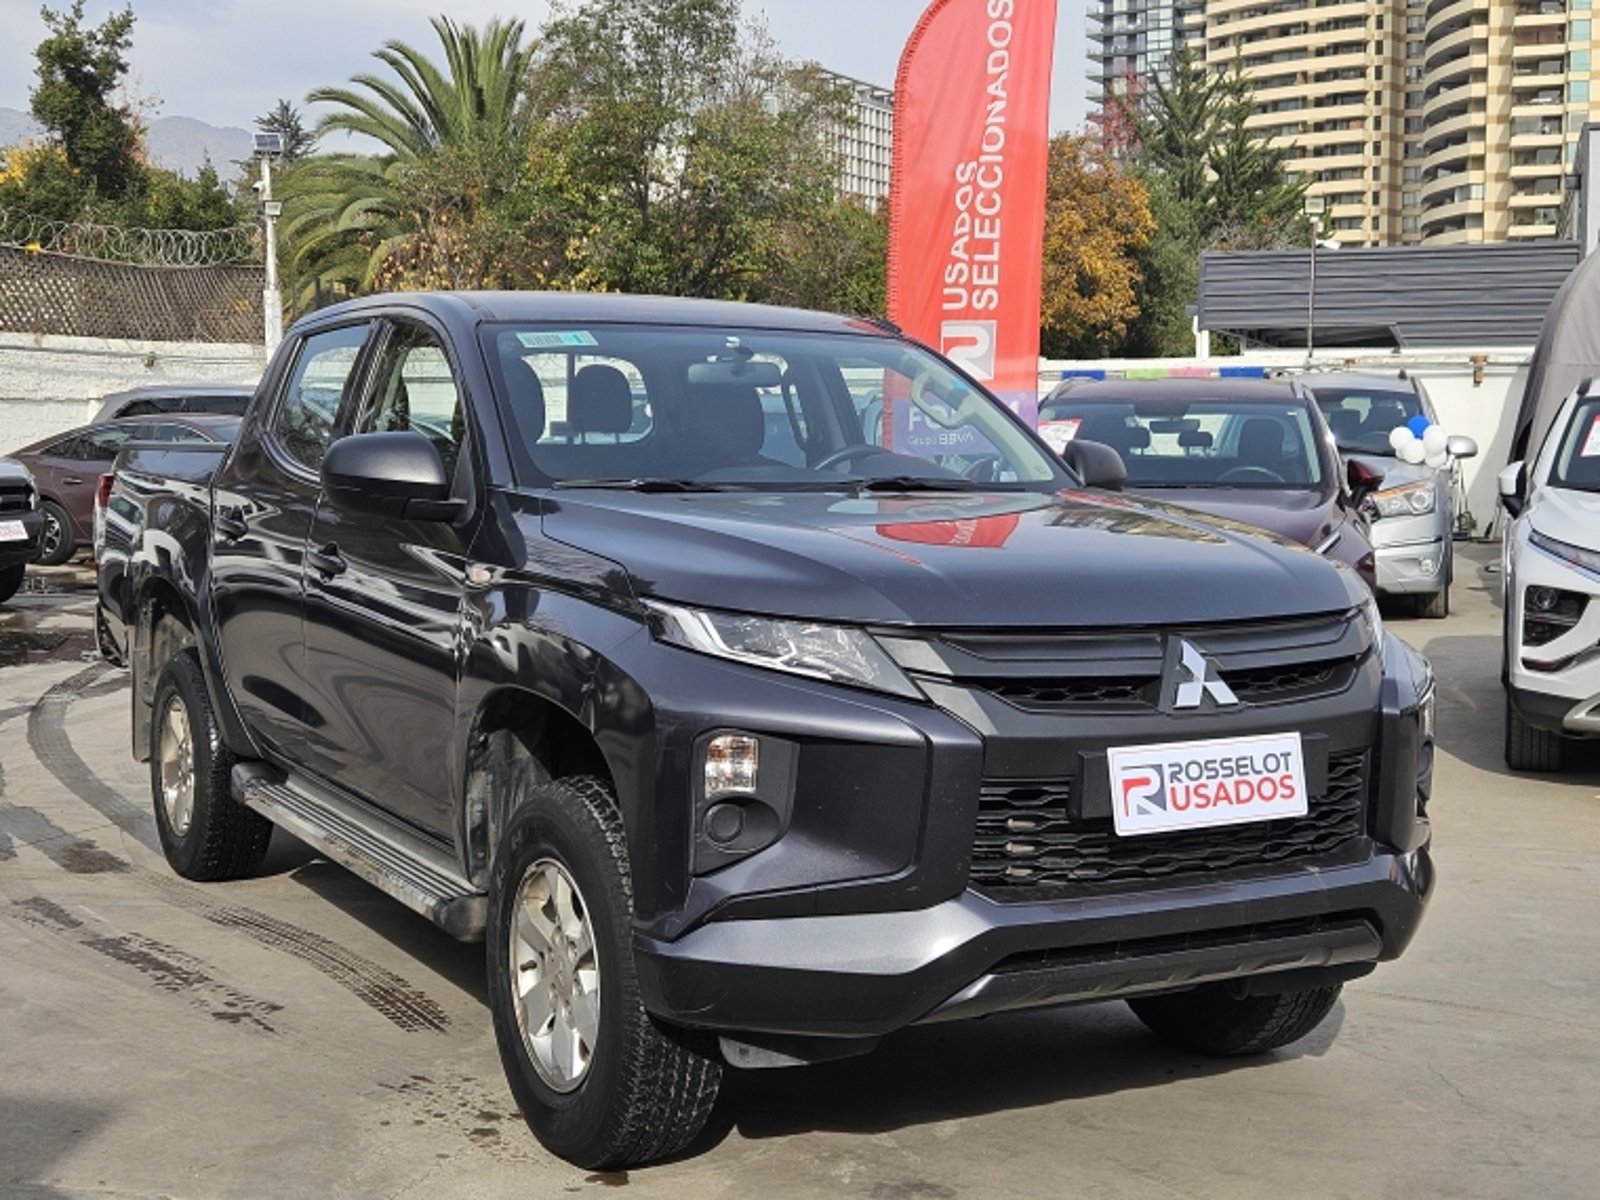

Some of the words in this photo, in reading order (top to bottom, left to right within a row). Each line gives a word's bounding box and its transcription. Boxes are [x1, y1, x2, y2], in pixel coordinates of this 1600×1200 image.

[971, 0, 1014, 311] SELECCIONADOS
[942, 161, 977, 311] USADOS
[1168, 752, 1292, 784] ROSSELOT
[1170, 774, 1296, 811] USADOS
